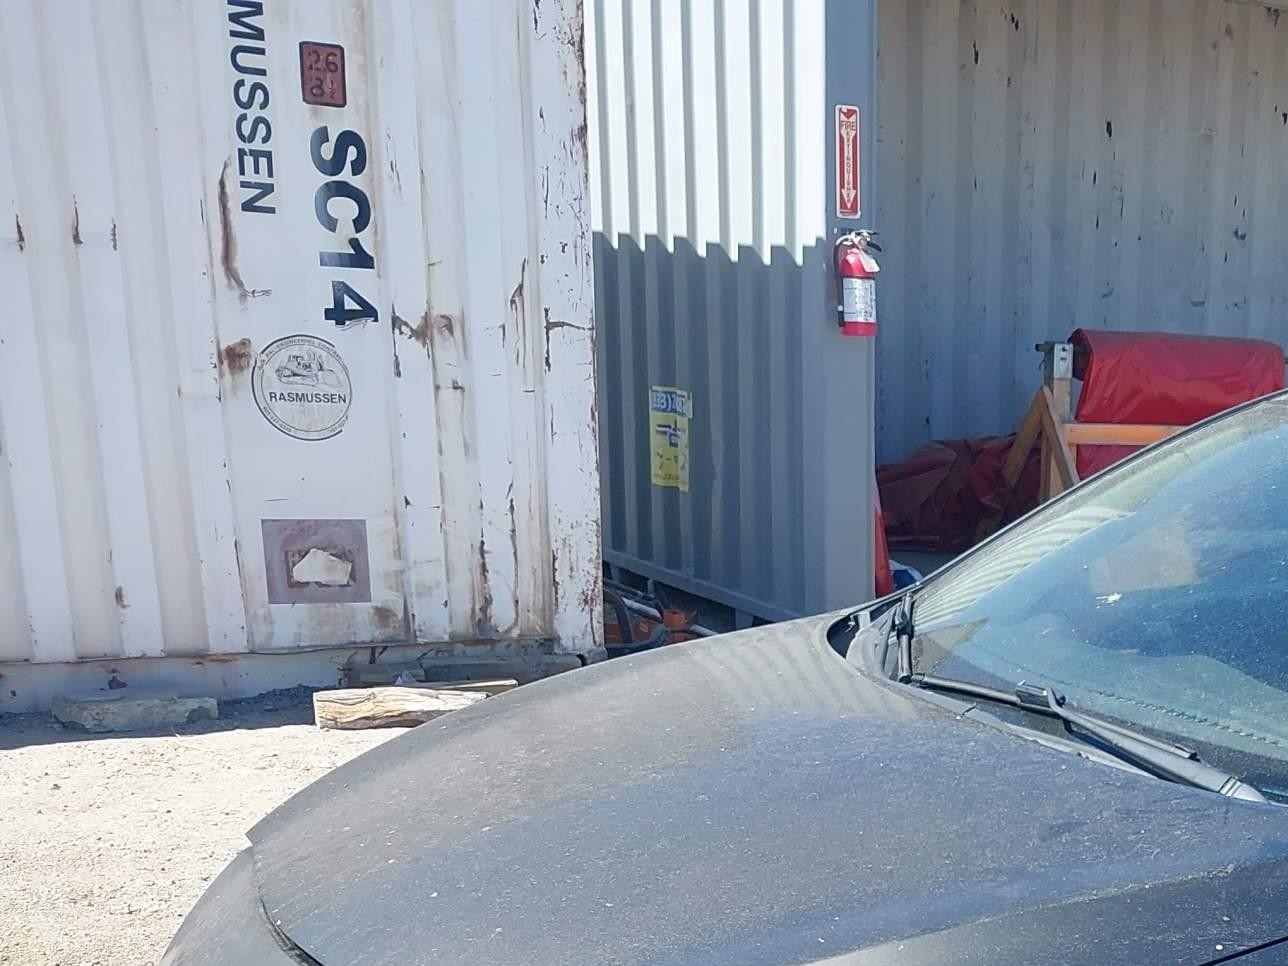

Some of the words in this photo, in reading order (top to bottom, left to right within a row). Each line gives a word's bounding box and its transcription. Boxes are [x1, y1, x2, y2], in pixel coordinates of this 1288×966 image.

[840, 120, 856, 130] FIRE
[310, 125, 379, 326] SC14
[268, 391, 347, 404] RASMUSSEN
